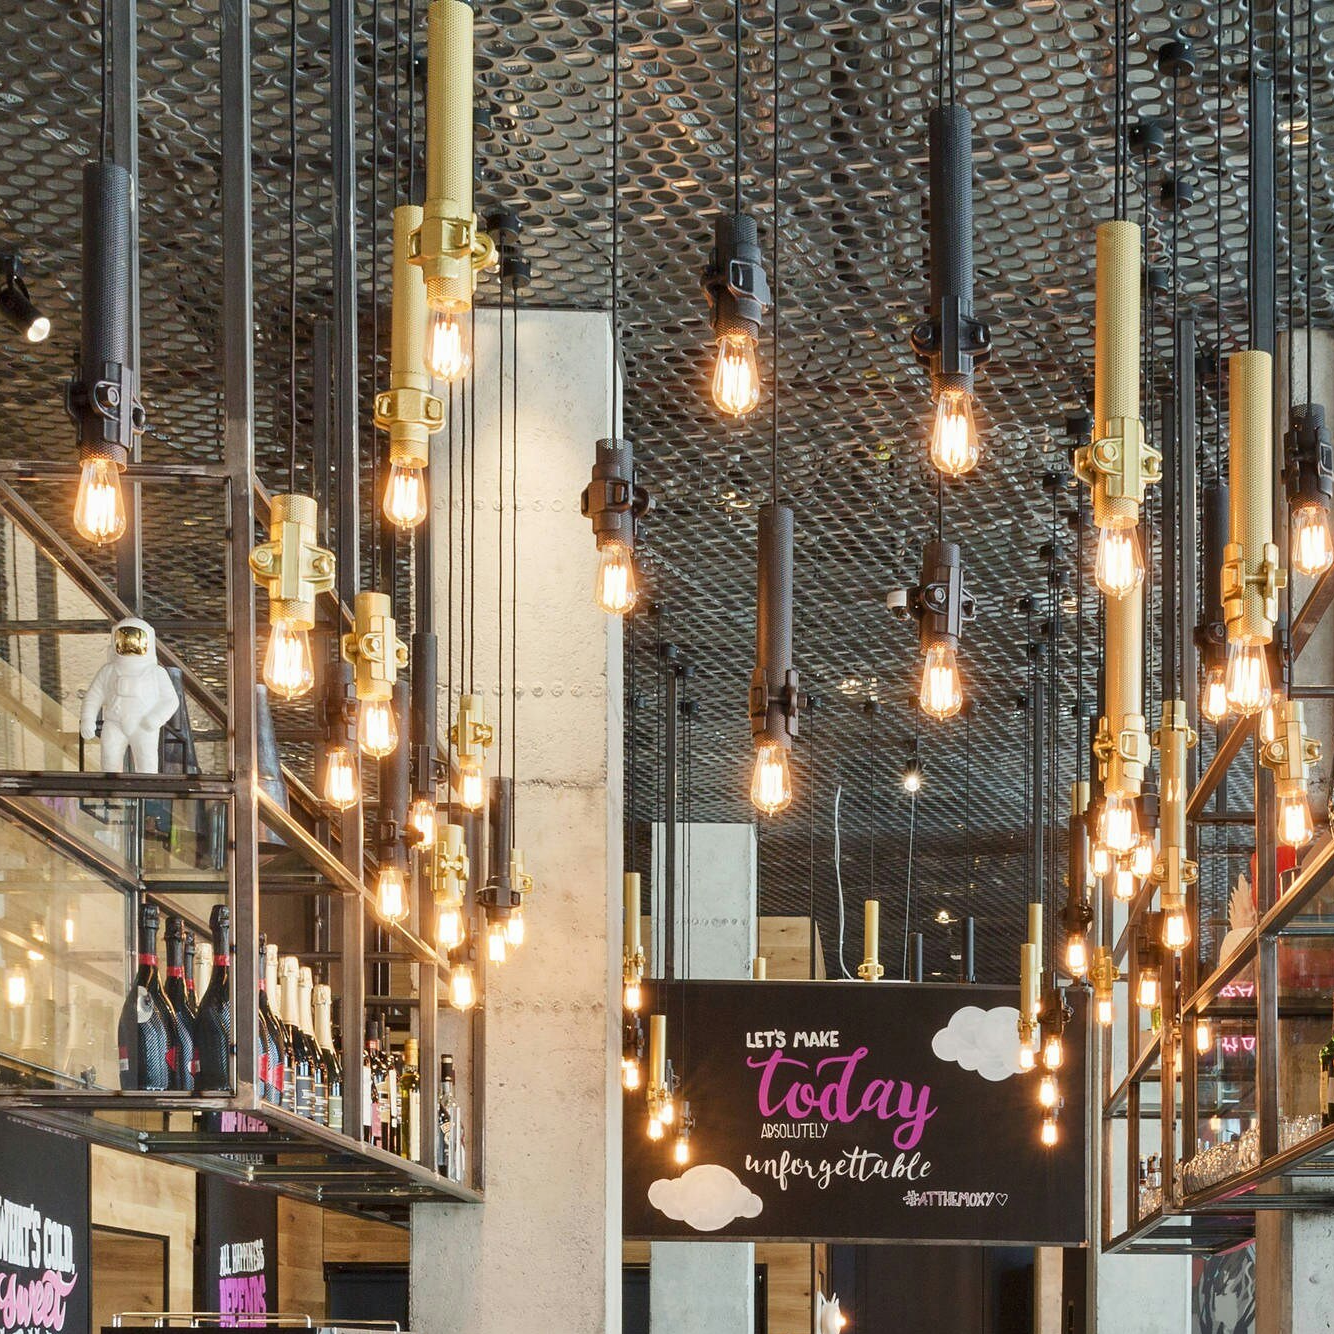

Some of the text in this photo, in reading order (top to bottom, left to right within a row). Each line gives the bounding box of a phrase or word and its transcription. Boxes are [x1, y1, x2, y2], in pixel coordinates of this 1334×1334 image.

[746, 1028, 840, 1049] LET'S MAKE
[747, 1046, 939, 1150] today
[760, 1122, 829, 1139] ABSOLUTELY
[745, 1145, 933, 1191] unforgettable
[902, 1190, 995, 1207] #ATTHEMOXY
[219, 1238, 265, 1277] ALL HAPPINESS
